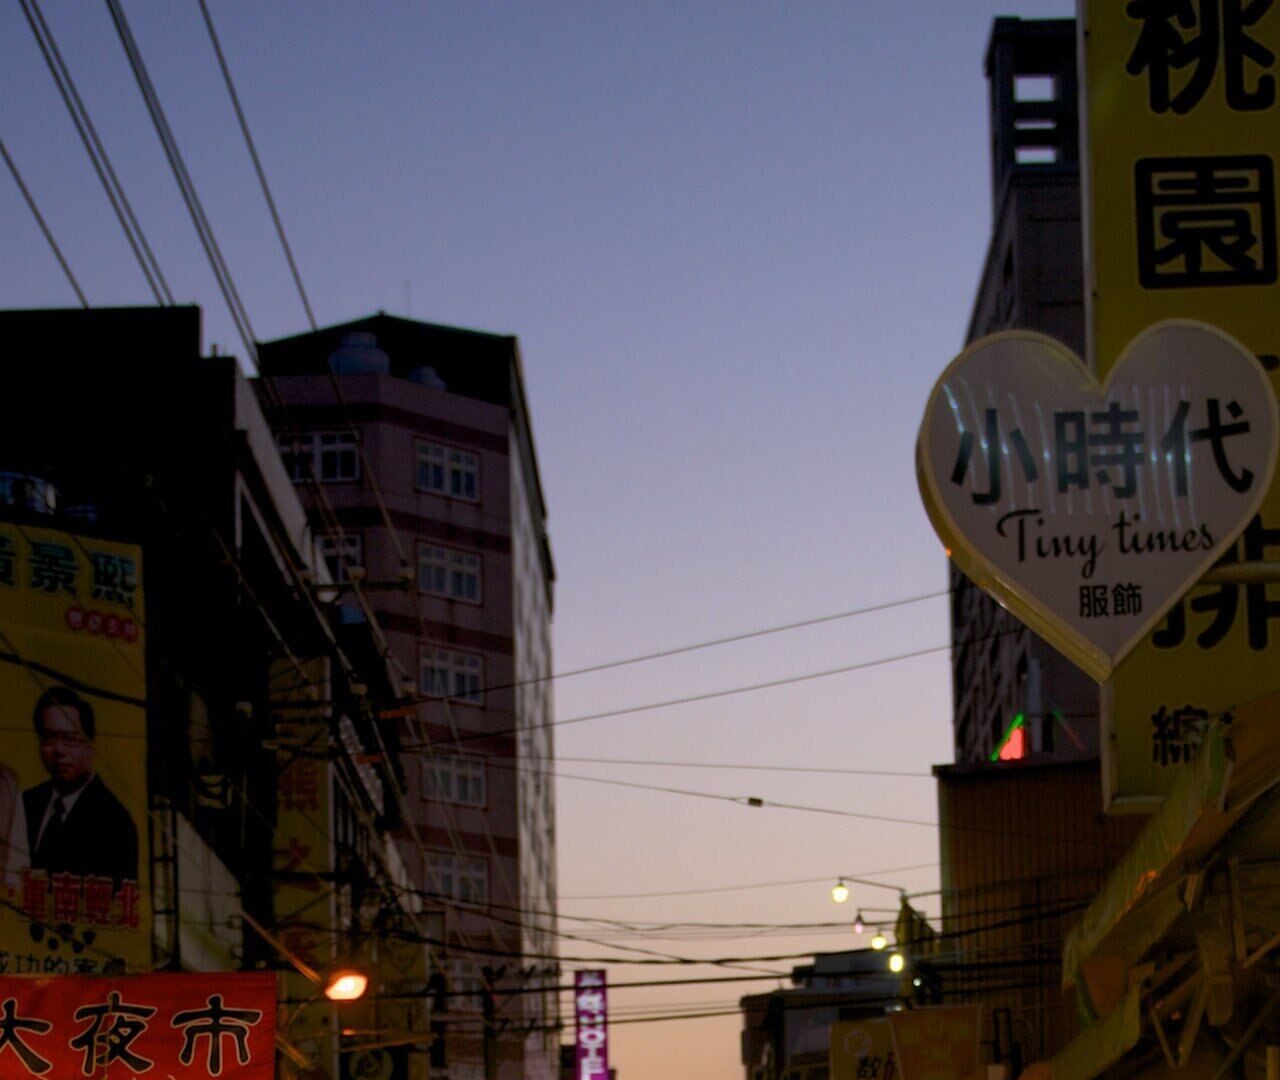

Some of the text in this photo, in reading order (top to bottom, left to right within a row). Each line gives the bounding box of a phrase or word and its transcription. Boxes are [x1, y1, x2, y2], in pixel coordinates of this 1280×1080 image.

[951, 398, 1254, 506] 小時代
[996, 508, 1218, 577] Tiny times
[1077, 582, 1144, 619] 服飾
